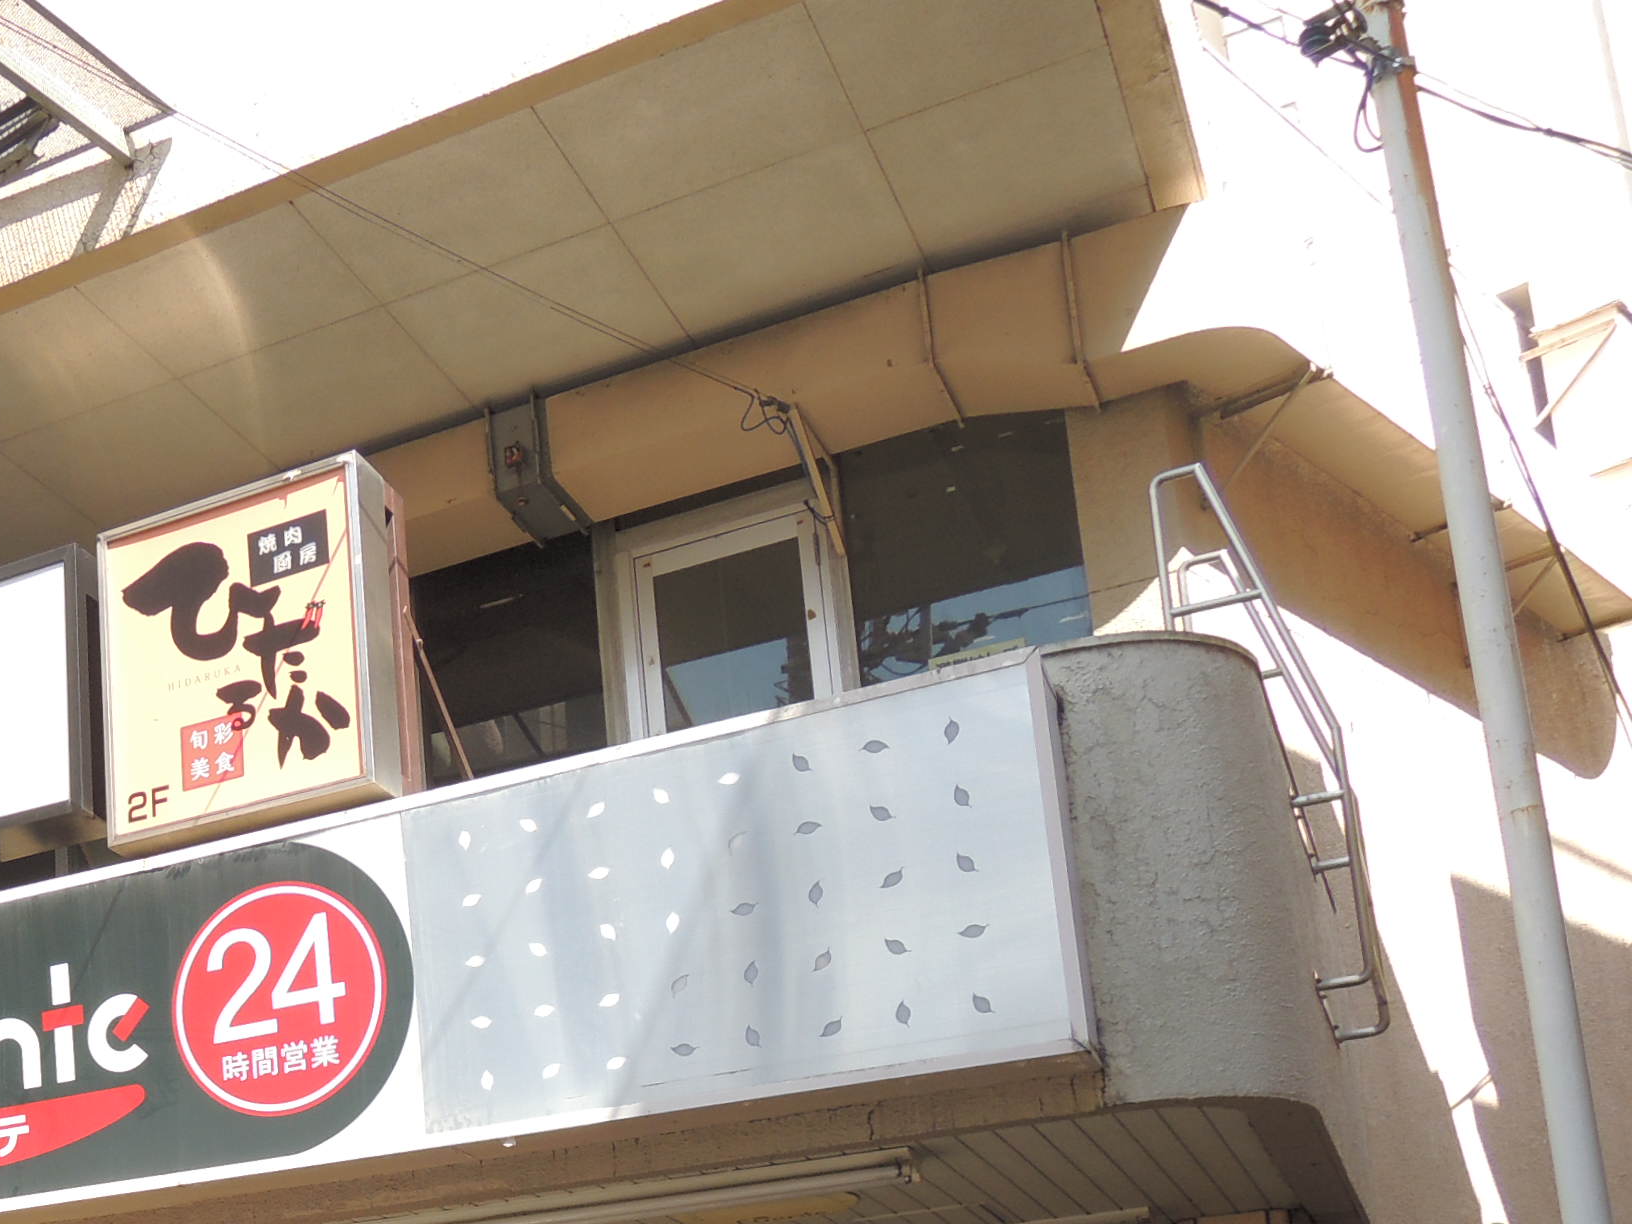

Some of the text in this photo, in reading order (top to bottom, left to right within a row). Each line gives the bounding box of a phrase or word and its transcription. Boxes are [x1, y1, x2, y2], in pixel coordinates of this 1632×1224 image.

[258, 526, 303, 555] 焼肉
[273, 543, 317, 573] 厨房
[190, 751, 235, 781] 美食
[128, 784, 170, 824] 2F
[205, 911, 347, 1046] 24
[221, 1035, 342, 1083] 時間営業
